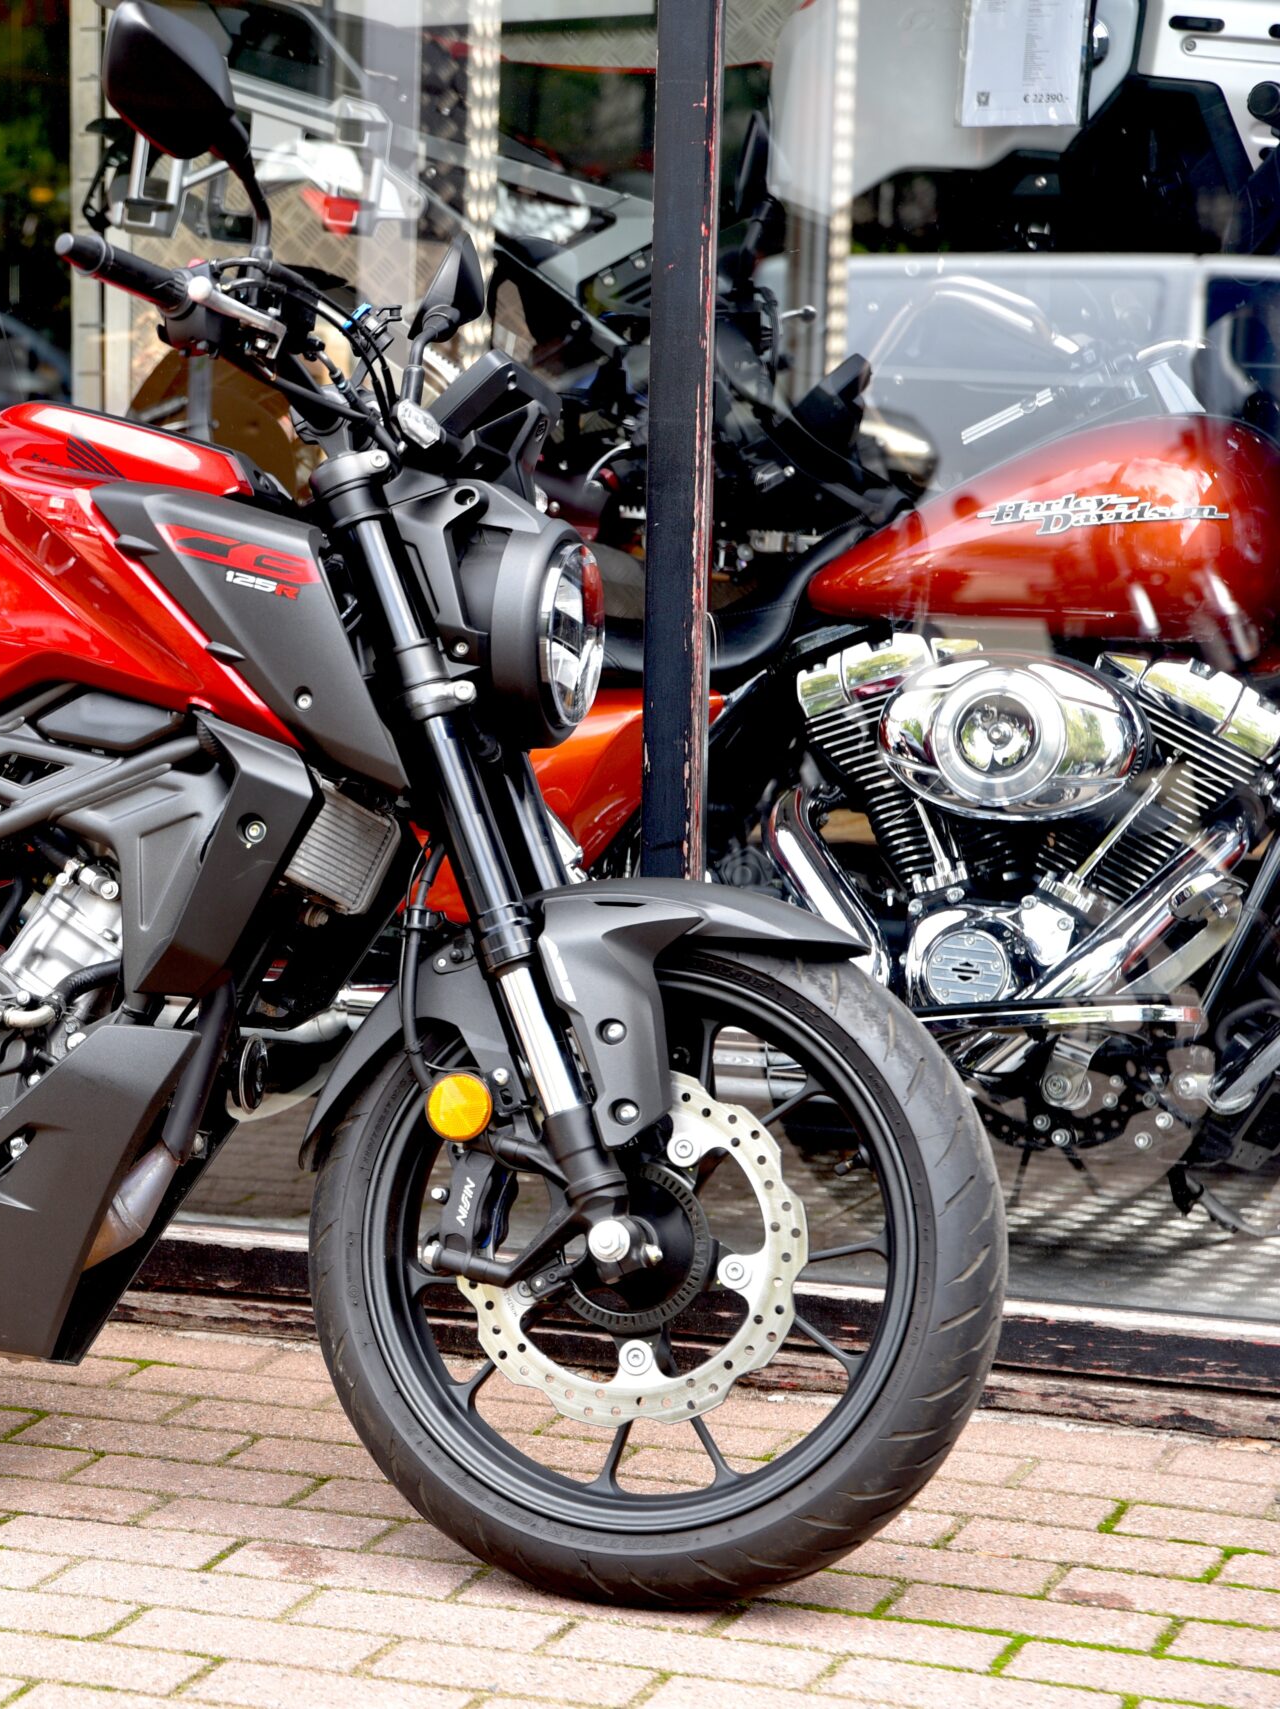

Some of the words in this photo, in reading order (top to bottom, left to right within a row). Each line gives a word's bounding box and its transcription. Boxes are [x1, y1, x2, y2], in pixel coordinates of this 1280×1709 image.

[978, 493, 1139, 525] Harley
[1036, 500, 1229, 536] Davidson
[158, 522, 322, 584] CB
[225, 570, 301, 600] 125R
[456, 1177, 477, 1227] NISSIN
